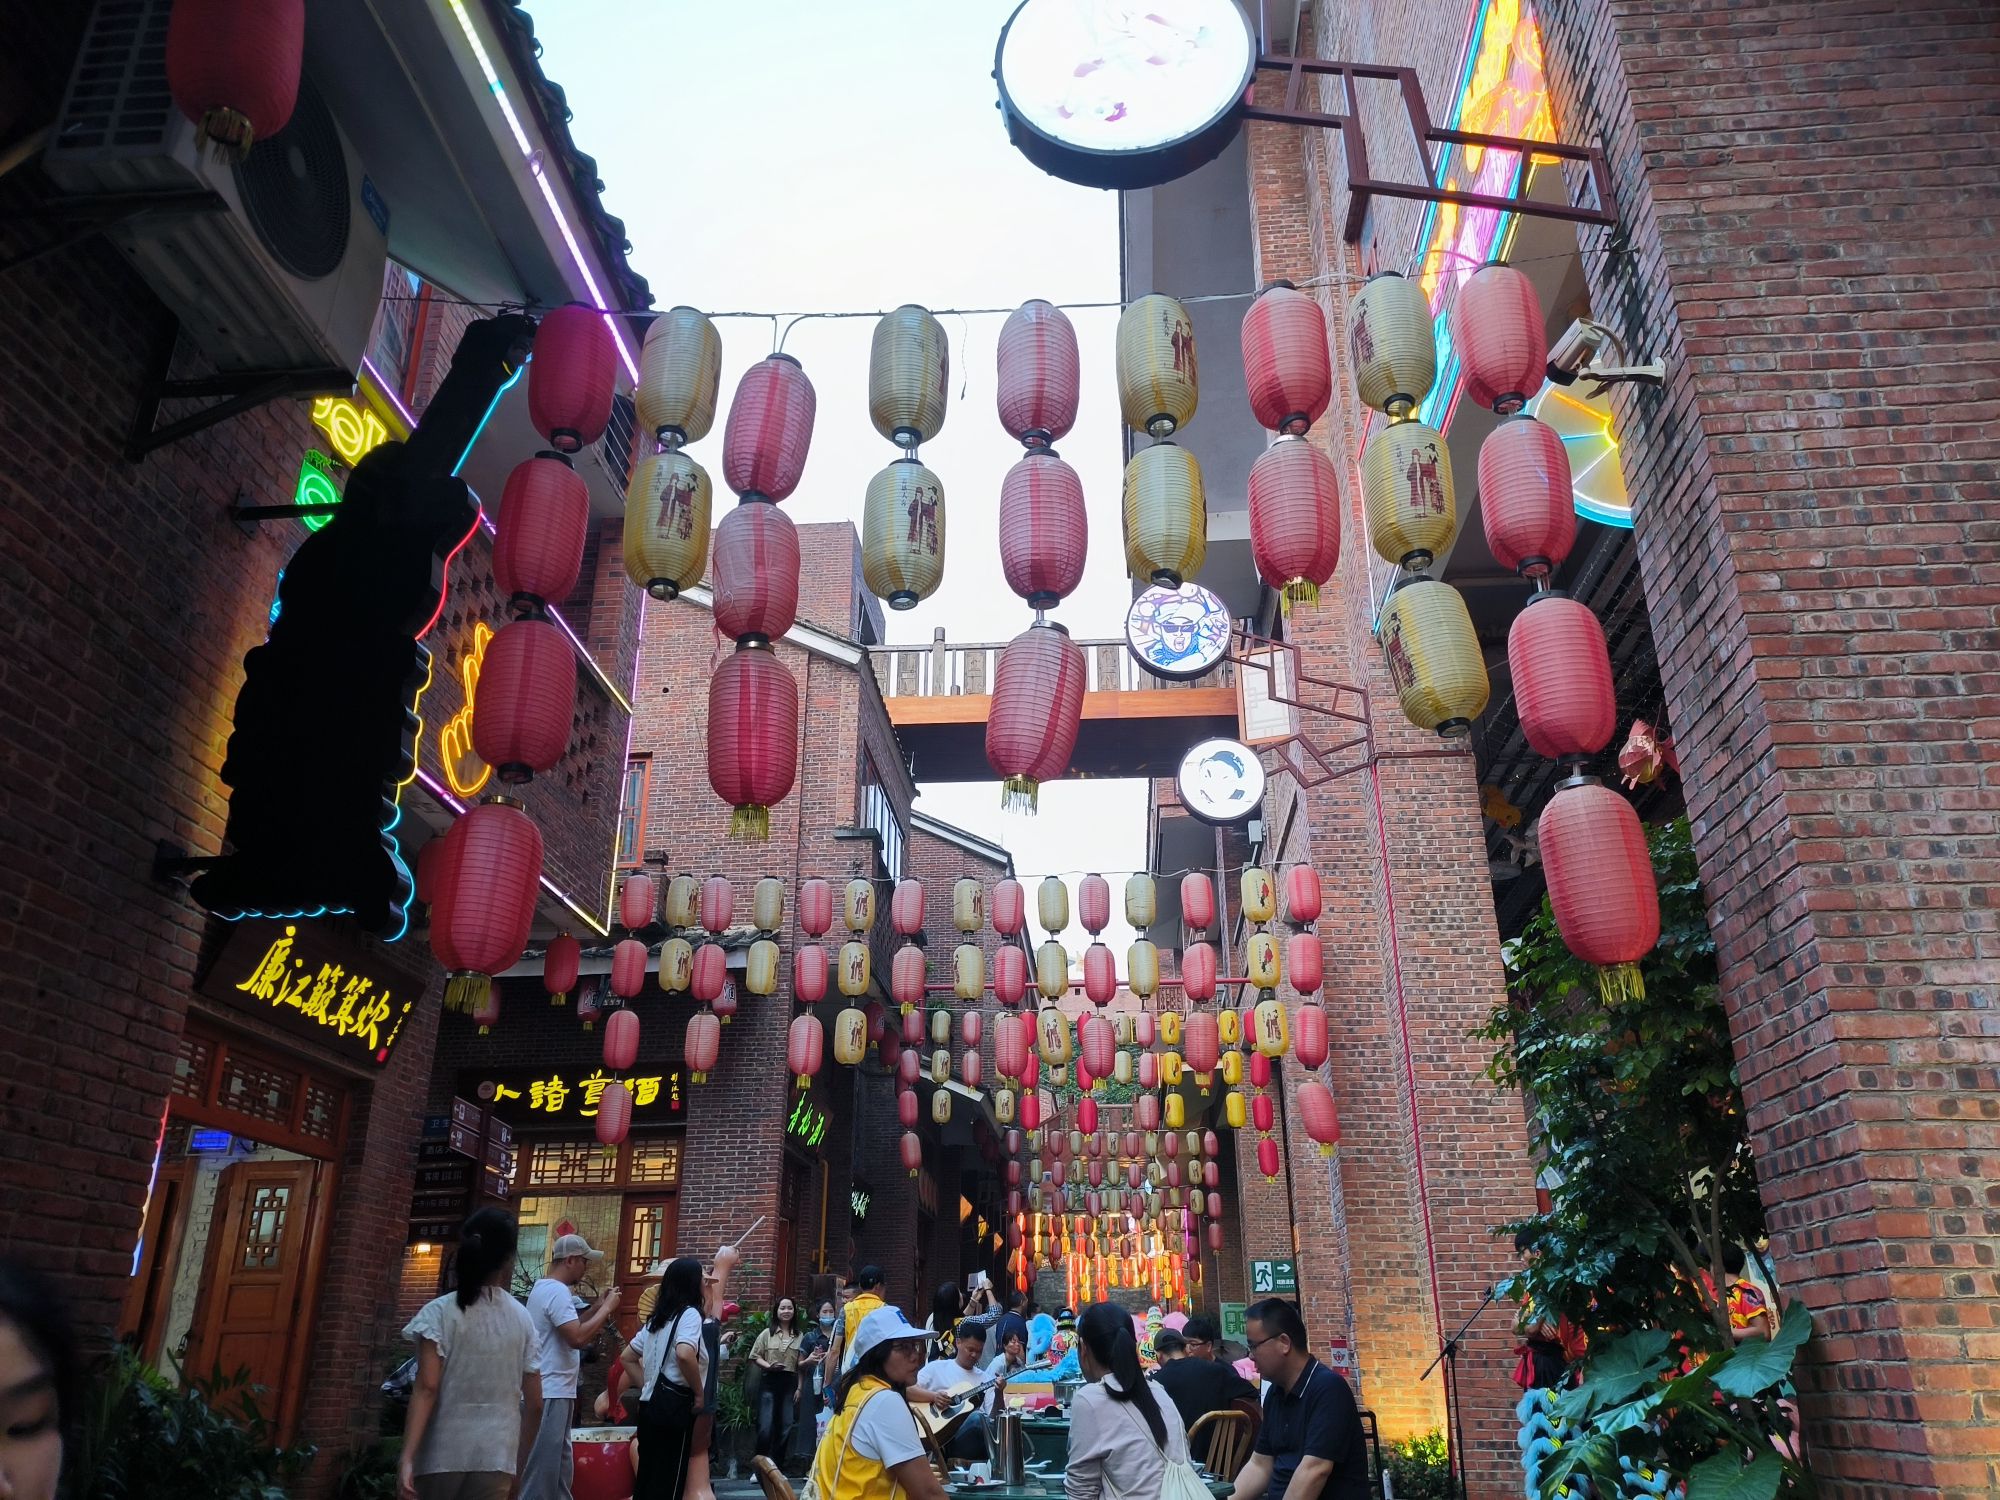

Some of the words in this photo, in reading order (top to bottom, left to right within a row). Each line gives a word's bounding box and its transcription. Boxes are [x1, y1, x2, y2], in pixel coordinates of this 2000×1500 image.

[236, 926, 390, 1050] 廉江簸箕炊
